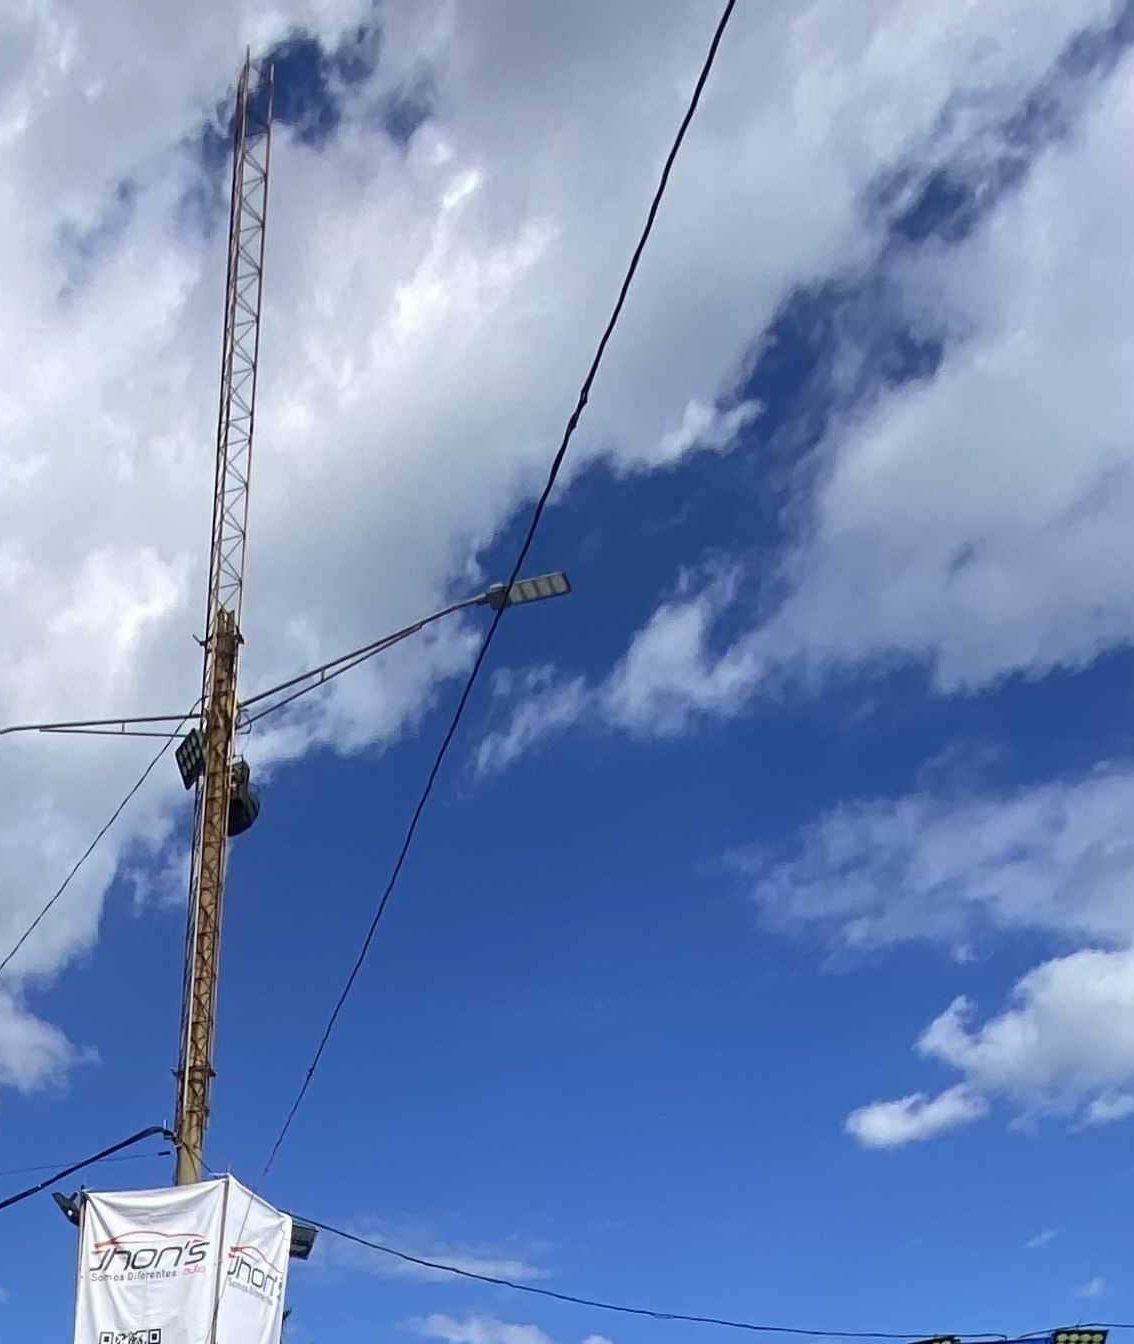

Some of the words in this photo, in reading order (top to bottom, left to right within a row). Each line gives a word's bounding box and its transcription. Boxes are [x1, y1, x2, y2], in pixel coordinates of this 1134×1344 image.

[89, 1240, 210, 1272] Jhon's
[91, 1272, 125, 1282] Somos
[127, 1269, 177, 1280] Diferentes
